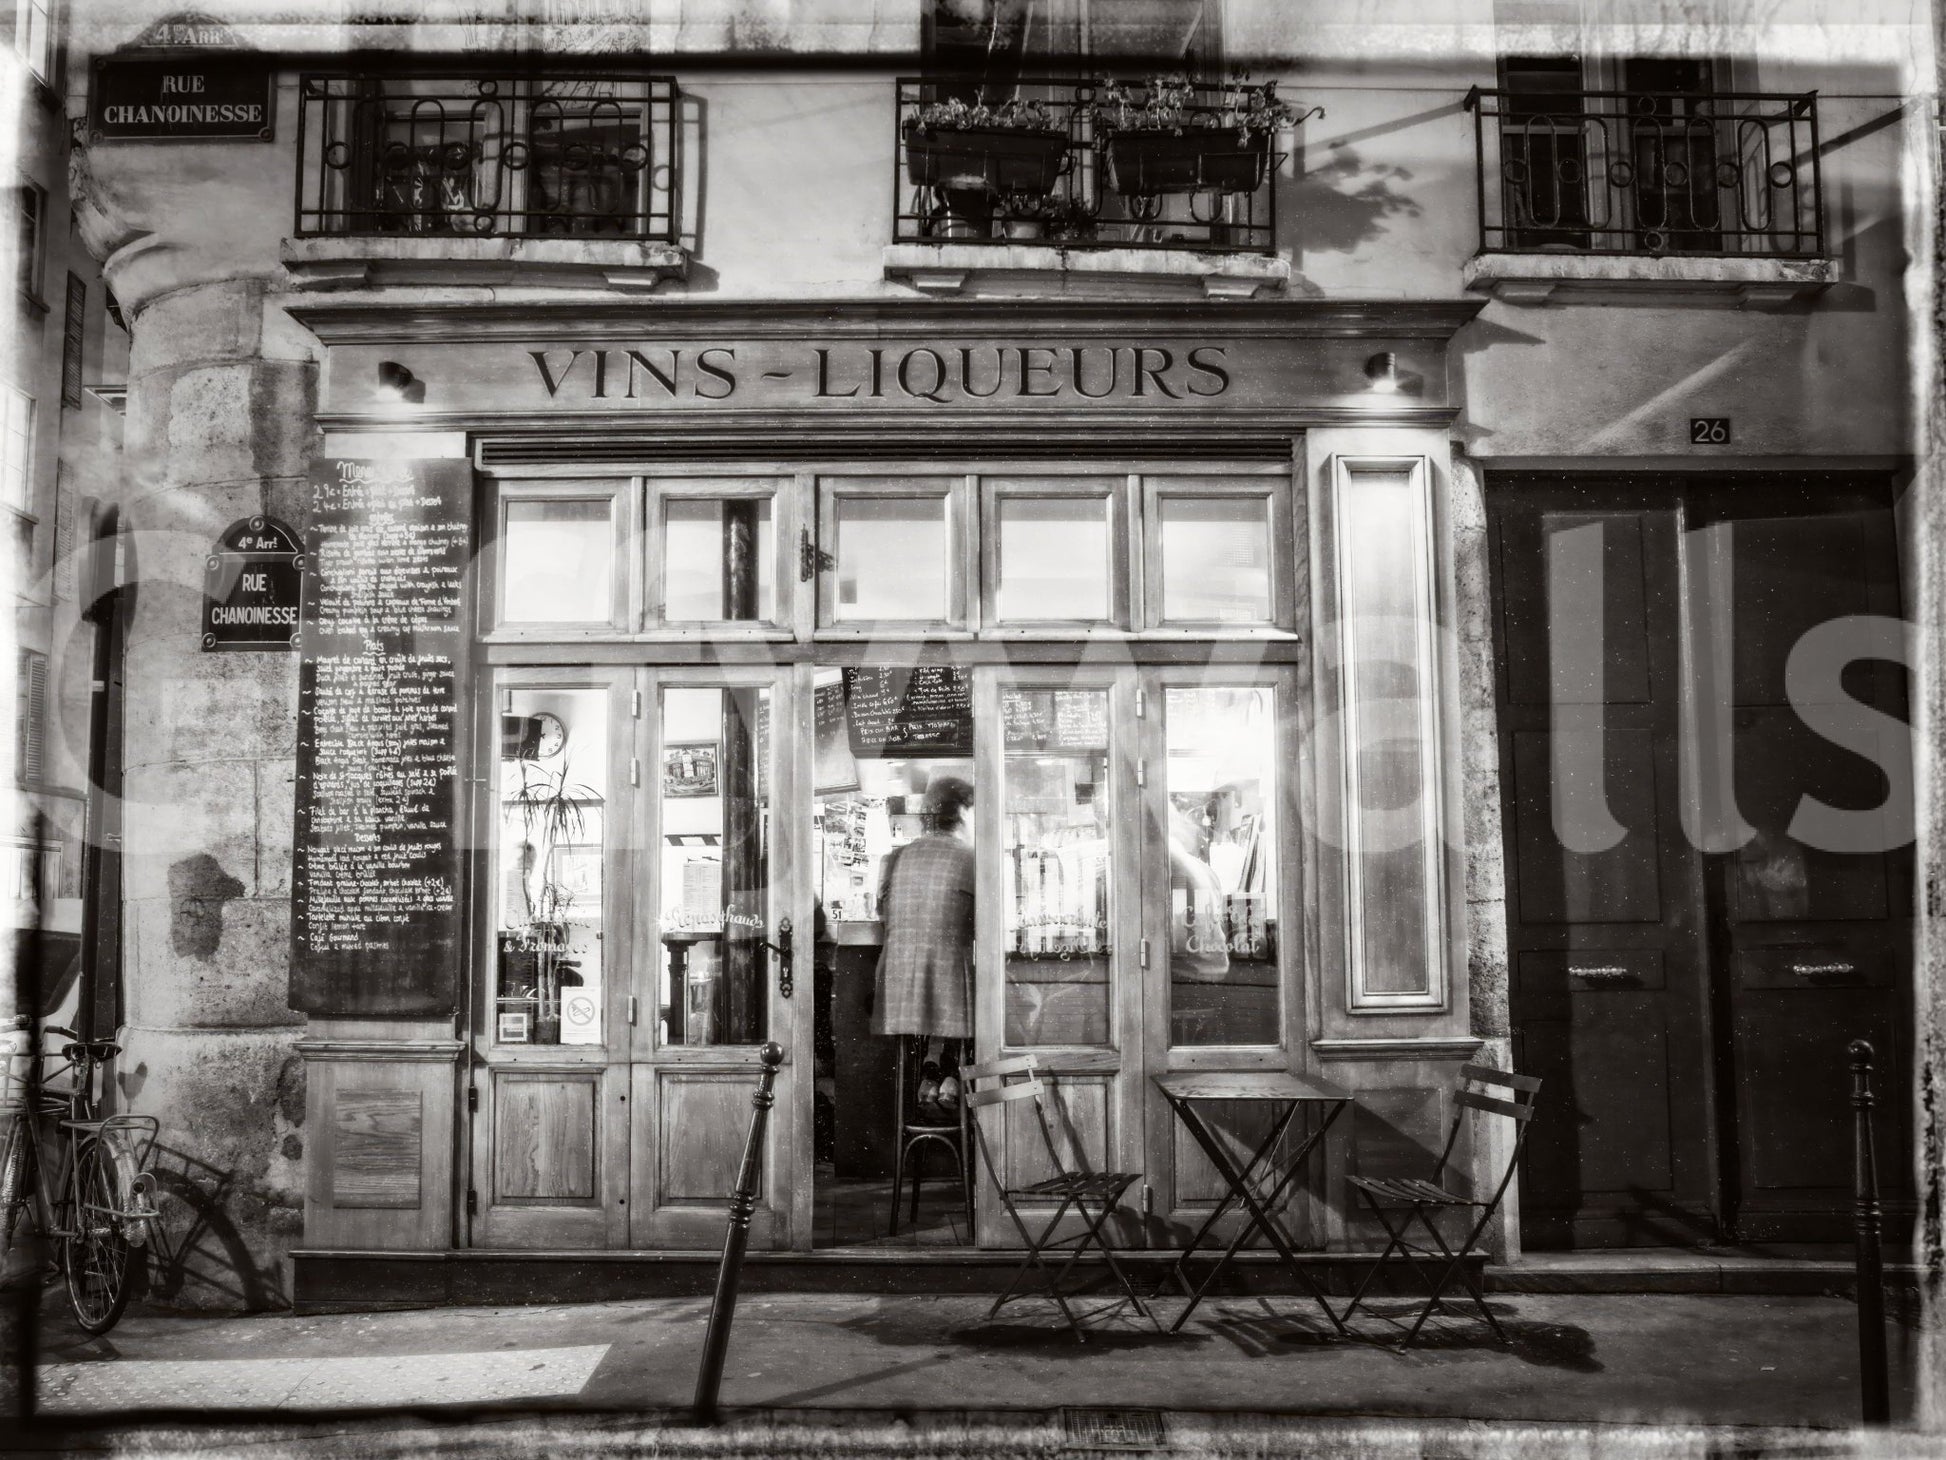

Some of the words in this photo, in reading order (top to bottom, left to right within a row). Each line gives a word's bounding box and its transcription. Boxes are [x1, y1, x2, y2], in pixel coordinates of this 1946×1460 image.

[163, 75, 205, 93] RUE
[104, 105, 262, 124] CHANOINESSE
[527, 348, 738, 398] VINS
[812, 347, 1230, 403] LIQUEURS
[1695, 420, 1726, 442] 26
[242, 574, 267, 591] RUE
[212, 607, 298, 624] CHANOINESSE
